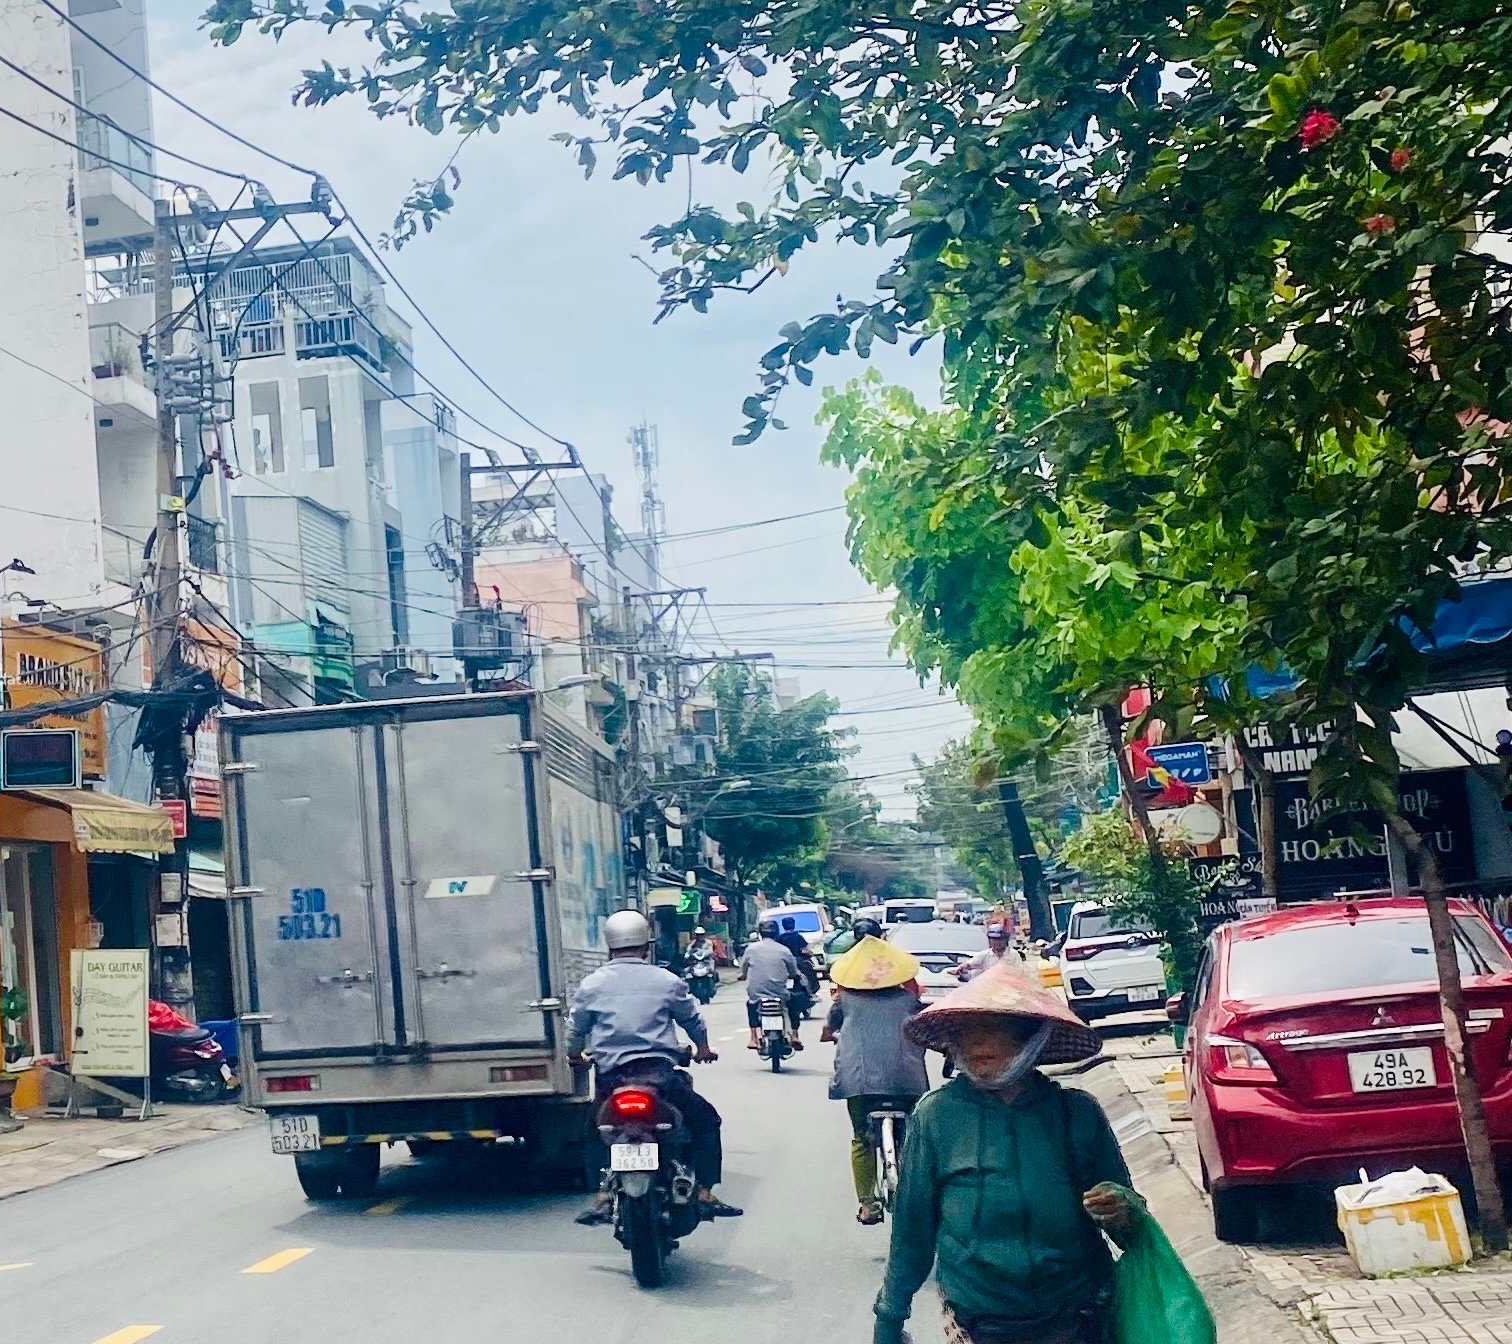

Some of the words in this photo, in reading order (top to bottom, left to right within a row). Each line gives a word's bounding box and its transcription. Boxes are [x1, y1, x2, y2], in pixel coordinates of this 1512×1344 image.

[291, 888, 326, 913] 51D
[278, 913, 341, 940] 503.21
[108, 962, 143, 972] GUITAR
[1374, 1052, 1408, 1069] 49A
[1362, 1069, 1426, 1088] 428.92
[282, 1117, 308, 1133] 51D
